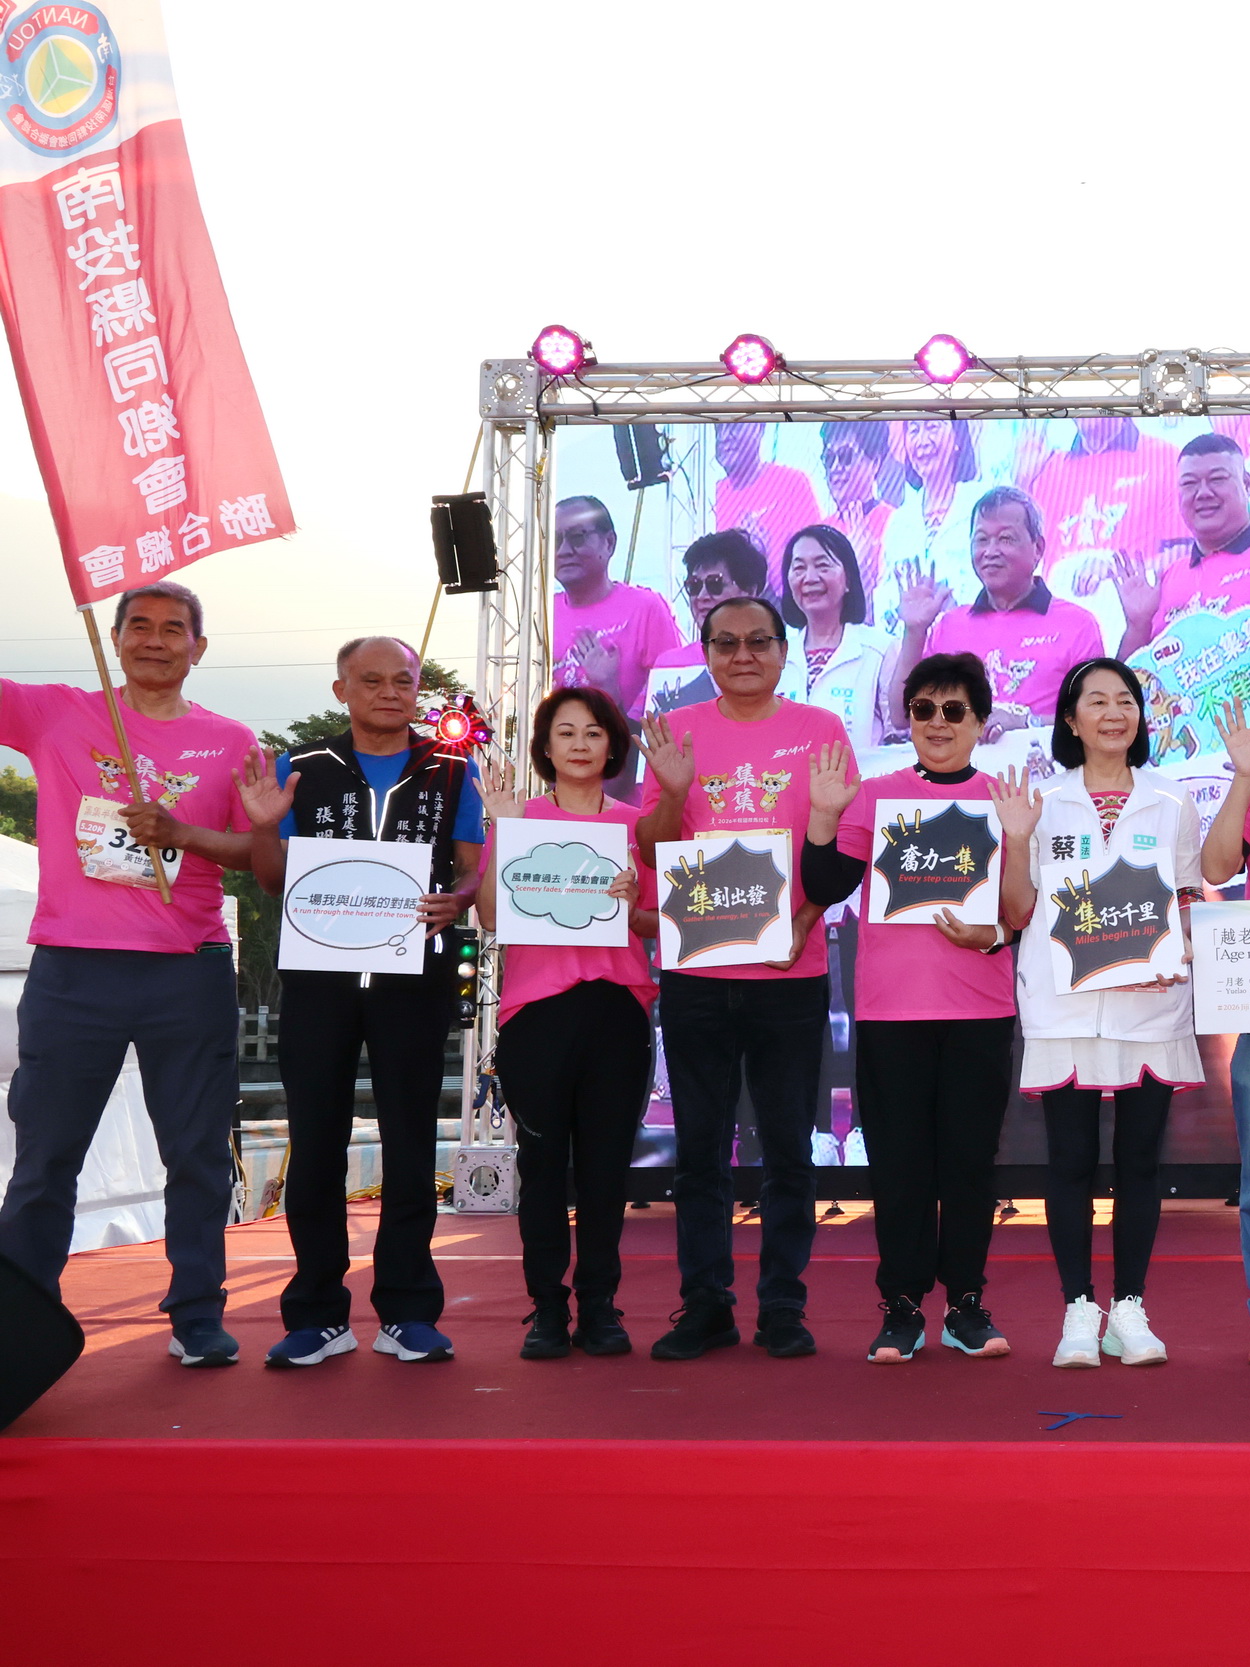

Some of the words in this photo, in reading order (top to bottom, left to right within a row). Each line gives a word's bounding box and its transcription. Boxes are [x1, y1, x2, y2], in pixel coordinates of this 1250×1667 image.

[732, 762, 757, 813] 集集
[80, 821, 104, 833] 5.20K
[1052, 835, 1075, 860] 蔡
[900, 843, 976, 876] 奮力一集
[899, 874, 921, 883] Every
[923, 875, 941, 883] step
[943, 875, 973, 883] counts.
[515, 885, 542, 894] Scenery
[687, 880, 768, 916] 集刻出發
[295, 893, 418, 910] 一場我與山城的對話
[313, 908, 340, 916] through
[1074, 897, 1159, 935] 集行千里
[1075, 935, 1100, 945] Miles
[1102, 930, 1129, 941] begin
[1131, 928, 1140, 936] in
[1142, 925, 1158, 937] Jiji.
[1225, 987, 1247, 995] Yuelao
[1241, 1003, 1250, 1012] Jiji
